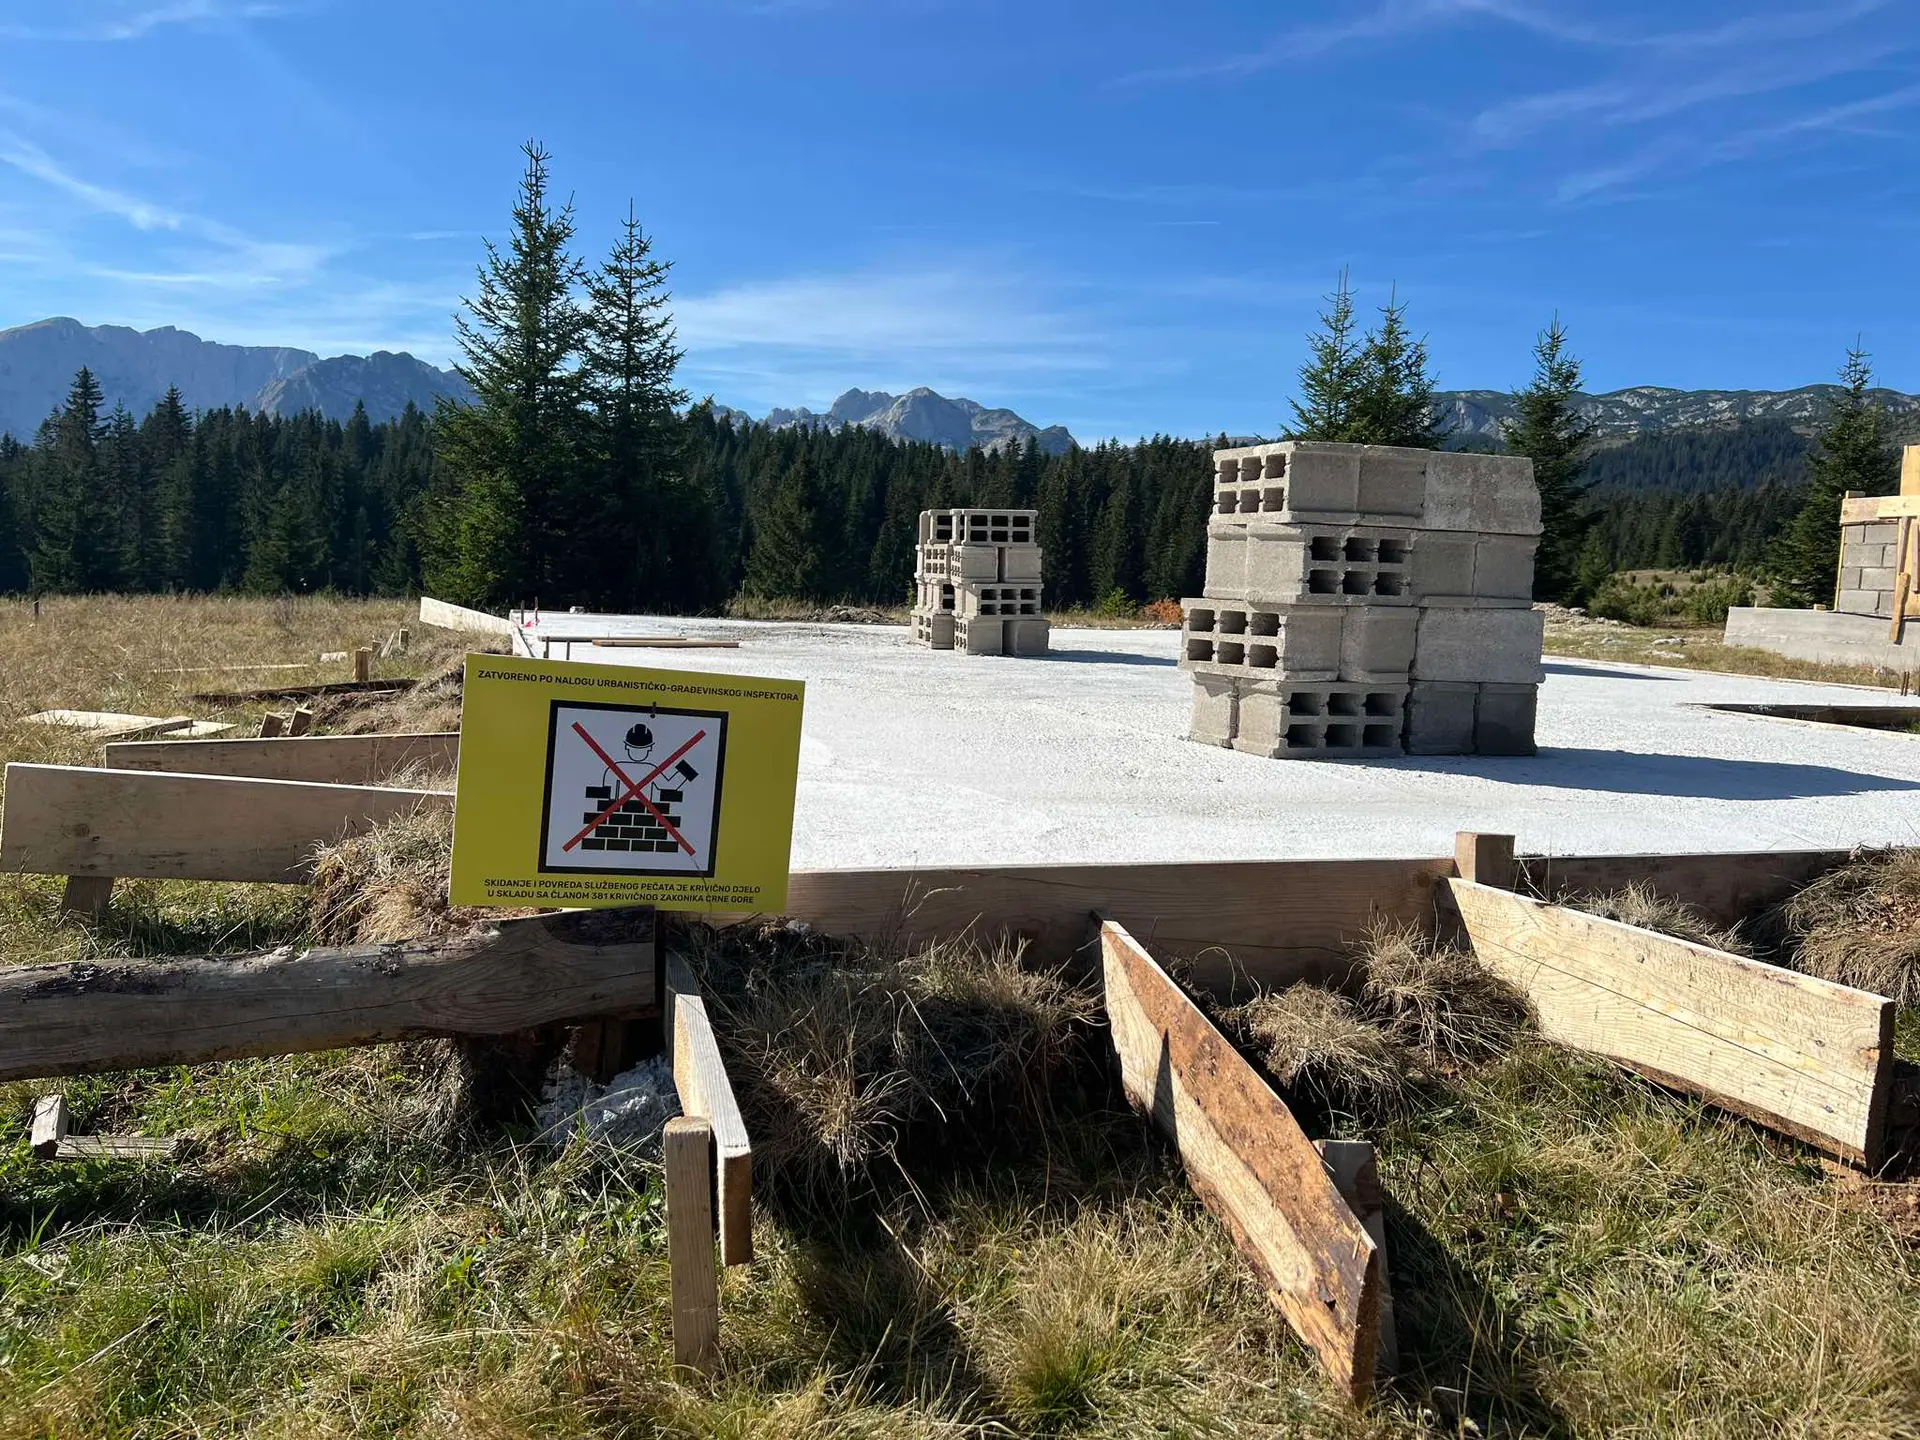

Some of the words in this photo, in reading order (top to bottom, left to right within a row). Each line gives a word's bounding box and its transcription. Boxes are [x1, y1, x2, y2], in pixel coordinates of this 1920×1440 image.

[478, 670, 537, 682] ZATVORENO
[539, 675, 553, 683] PO
[555, 676, 595, 686] NALOGU
[743, 690, 799, 701] INSPEKTORA
[484, 879, 531, 887] SKIDANJE
[539, 880, 582, 889] POVREDA
[584, 880, 639, 890] SLUŽBENOG
[640, 882, 675, 891] PEČATA
[676, 883, 688, 892] JE
[689, 883, 731, 893] KRIVIČNO
[732, 885, 761, 893] DJELO
[487, 890, 494, 898] U
[496, 890, 534, 898] SKLADU
[551, 889, 590, 899] ČLANOM
[591, 892, 608, 900] 381
[609, 891, 659, 901] KRIVIČNOG
[660, 893, 704, 902] ZAKONIKA
[730, 895, 754, 903] GORE
